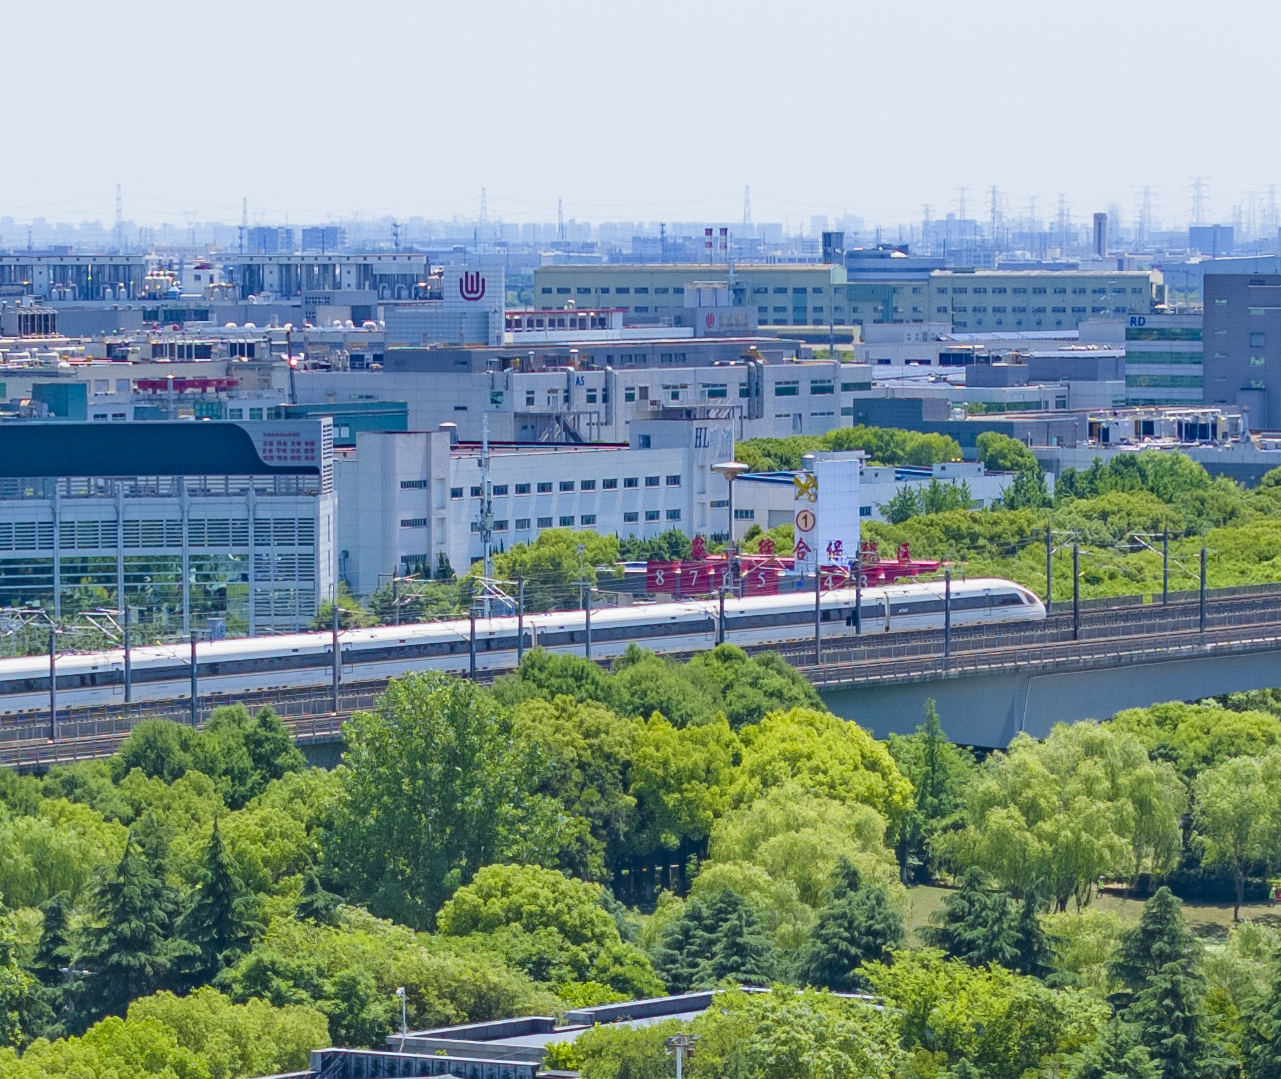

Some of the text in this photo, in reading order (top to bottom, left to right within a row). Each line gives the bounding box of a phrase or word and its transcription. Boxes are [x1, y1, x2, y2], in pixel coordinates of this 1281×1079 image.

[1130, 316, 1146, 327] RD
[575, 375, 586, 387] A5
[694, 426, 710, 449] HL
[655, 569, 665, 587] 8
[689, 570, 699, 587] 7
[756, 571, 766, 588] 5
[823, 575, 834, 590] 4
